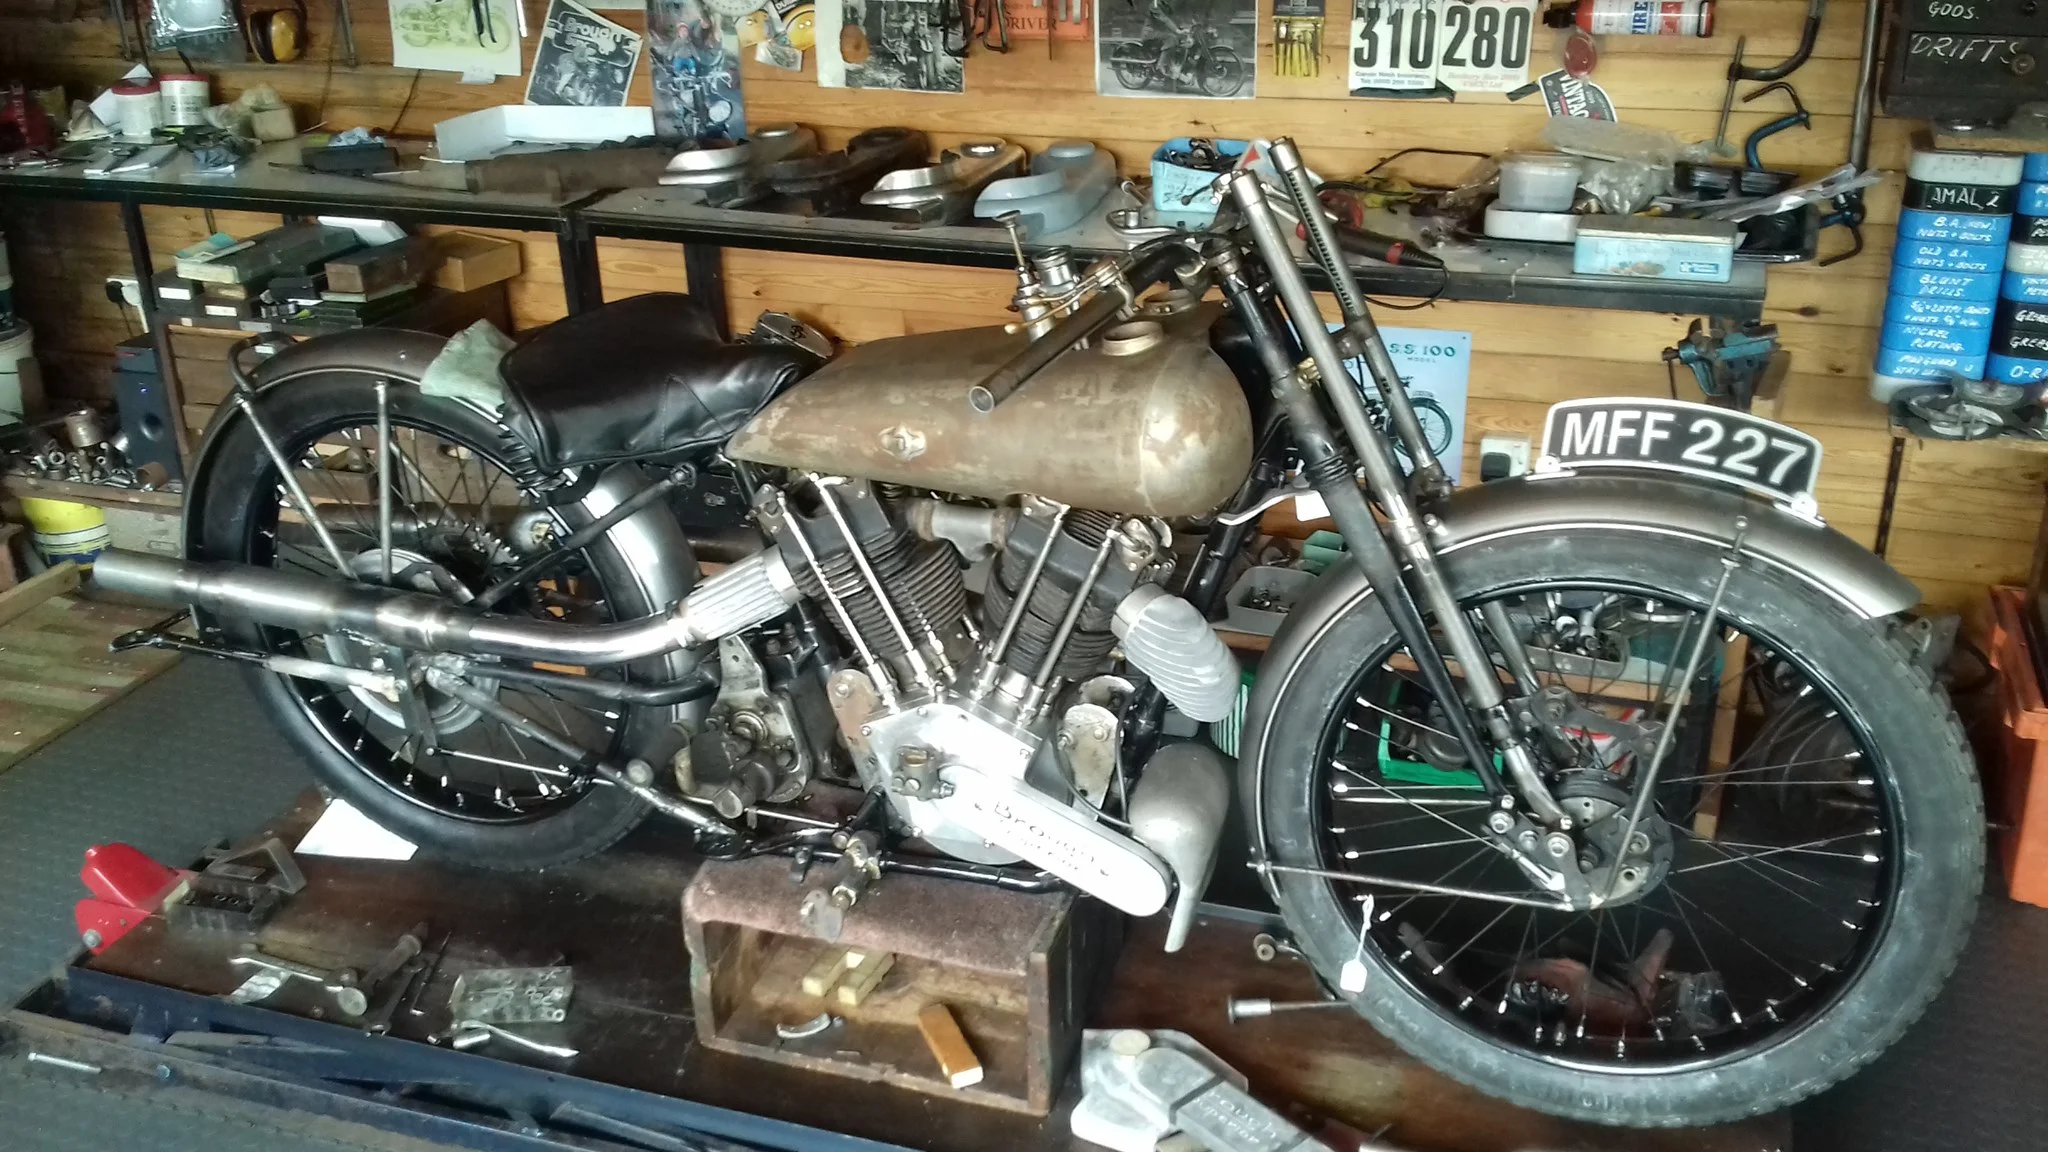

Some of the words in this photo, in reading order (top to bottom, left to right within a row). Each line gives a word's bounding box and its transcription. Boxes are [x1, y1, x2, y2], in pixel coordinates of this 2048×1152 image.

[1631, 1, 1649, 35] FIRE
[1354, 7, 1436, 69] 310
[1442, 5, 1531, 69] 280
[1911, 36, 2020, 63] DRIFTS
[1919, 273, 1975, 286] BLUNT
[1423, 345, 1456, 357] 100
[1560, 410, 1676, 456] MFF
[1681, 418, 1807, 486] 227
